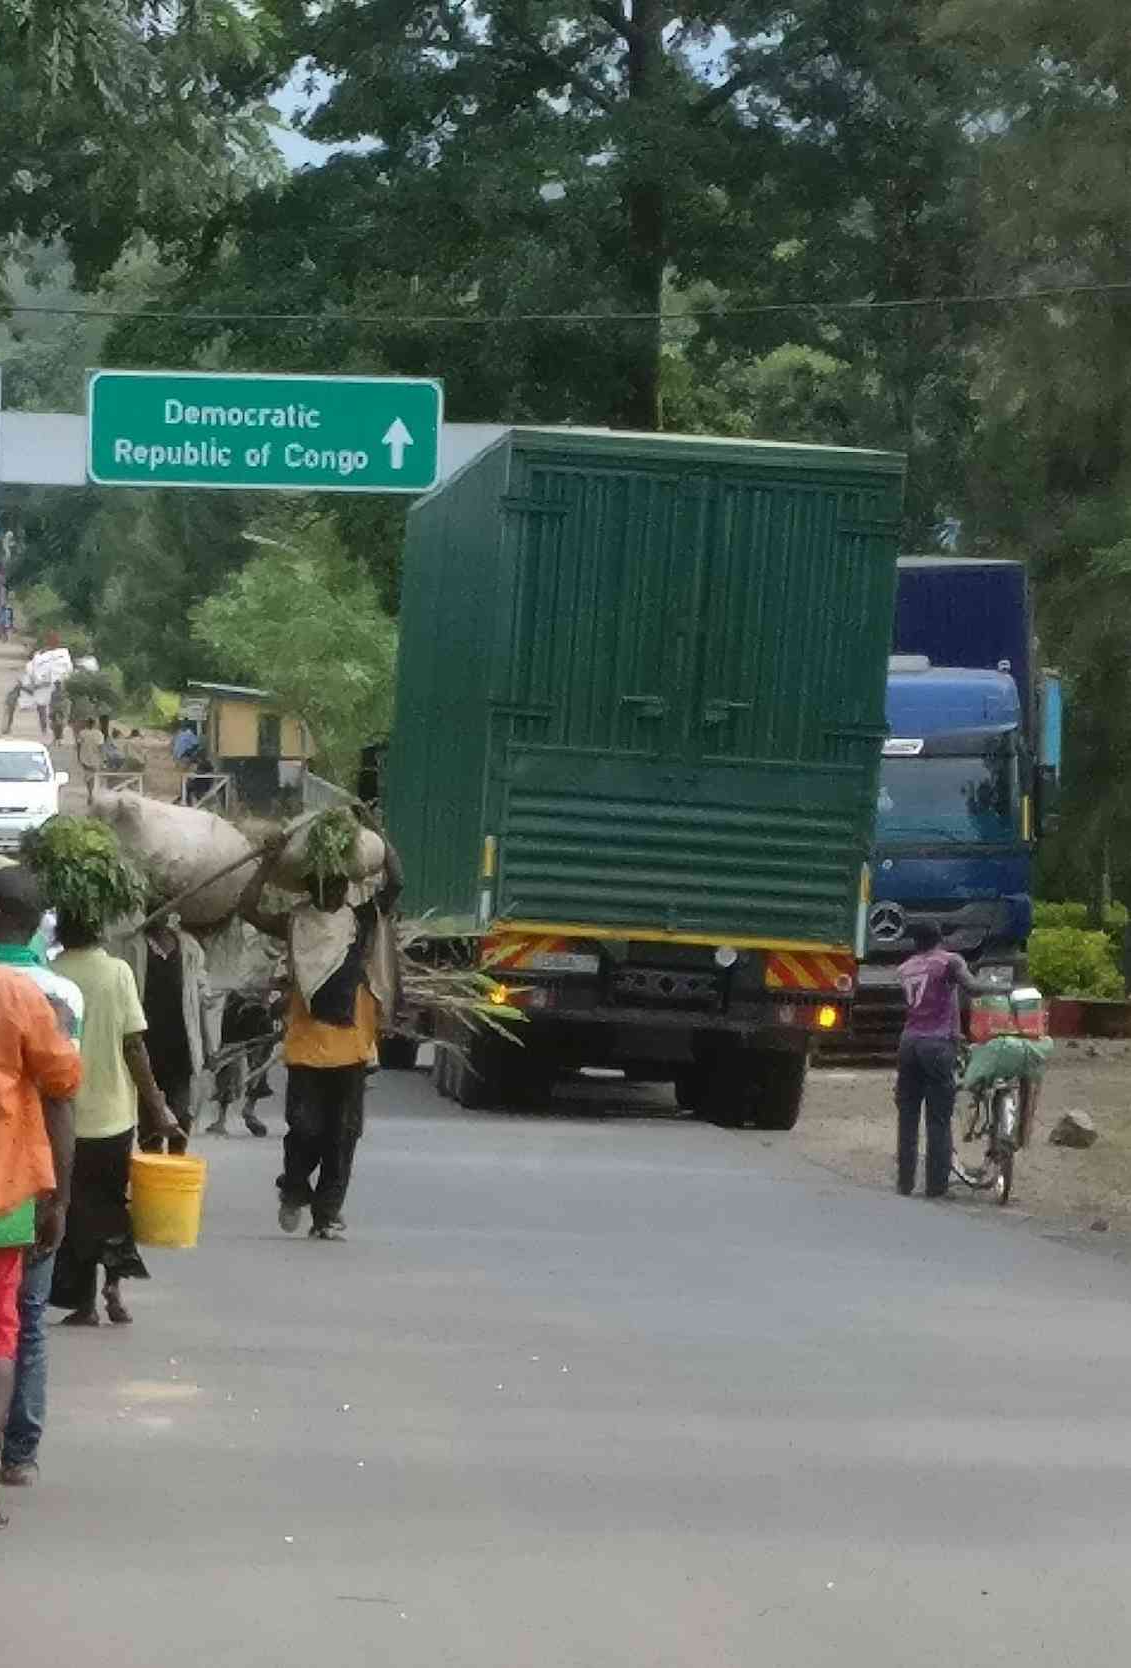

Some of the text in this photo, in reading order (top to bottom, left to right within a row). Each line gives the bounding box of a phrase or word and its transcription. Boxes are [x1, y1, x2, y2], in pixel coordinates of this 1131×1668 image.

[164, 399, 321, 428] Democratic
[114, 438, 369, 476] Republic of Congo
